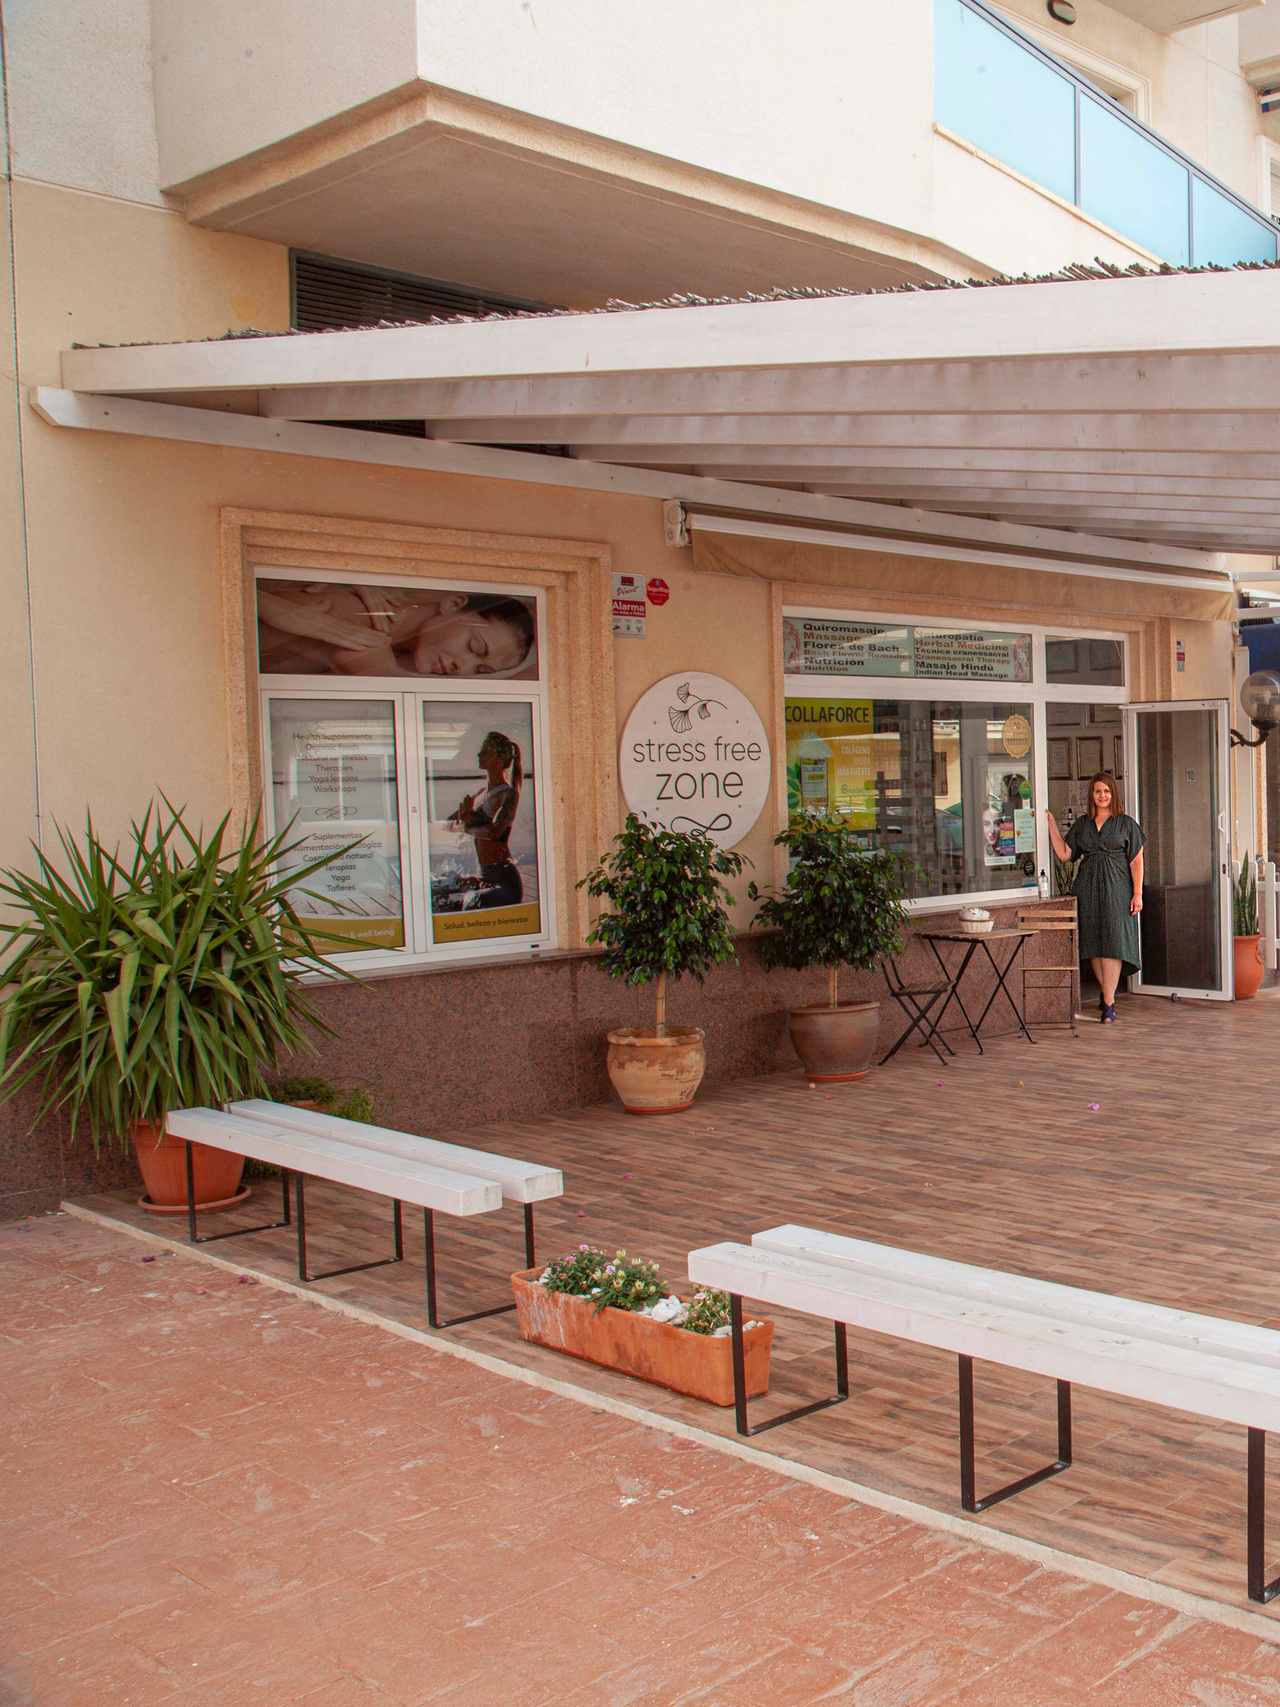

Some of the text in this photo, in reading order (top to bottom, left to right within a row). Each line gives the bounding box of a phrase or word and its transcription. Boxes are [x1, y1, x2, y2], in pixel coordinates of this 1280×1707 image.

[613, 601, 645, 612] Alarma
[803, 623, 885, 635] Quiromasaje
[803, 631, 1008, 652] Massage Herbal Medicine
[803, 641, 844, 650] Flores
[848, 642, 865, 651] de
[868, 643, 901, 652] Bach
[953, 649, 1010, 657] craneosacral
[804, 656, 994, 672] Nutrición Masaje Hindú
[867, 652, 913, 660] Remedies
[914, 654, 974, 662] Craneosacral
[976, 656, 1011, 665] Therapy
[970, 672, 1009, 680] Massage
[785, 706, 870, 723] COLLAFORCE
[293, 732, 373, 742] Health Supplements
[338, 742, 360, 750] foods
[633, 735, 762, 763] stress free
[309, 775, 330, 783] Yoga
[656, 772, 743, 801] zone
[312, 832, 364, 841] Suplementos
[345, 851, 374, 860] natural
[331, 874, 351, 882] Yoga
[327, 884, 356, 892] Talleres
[444, 916, 529, 930] Salud, belleza y bienestar
[357, 930, 373, 938] well
[374, 928, 395, 938] being
